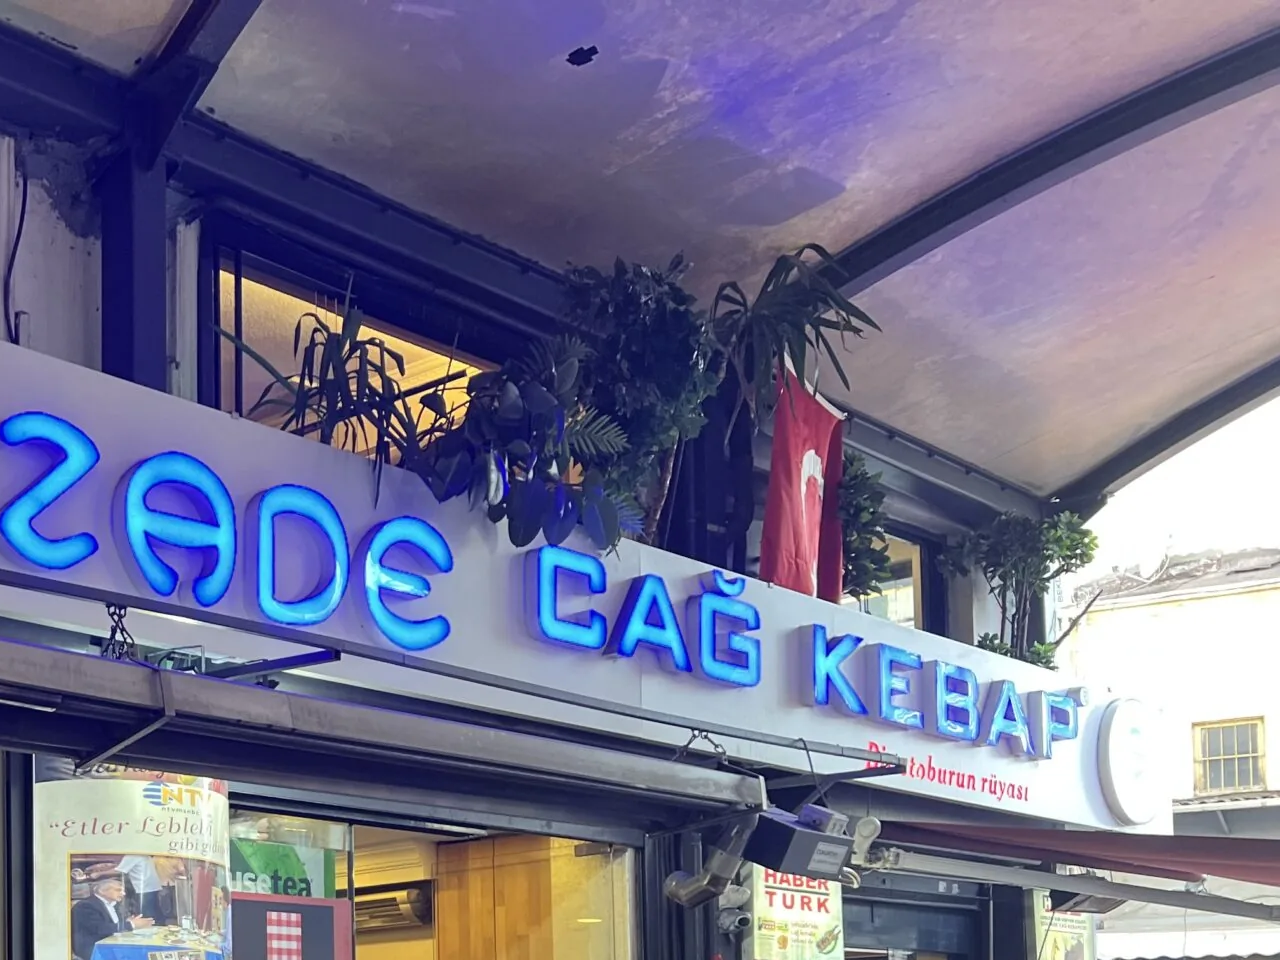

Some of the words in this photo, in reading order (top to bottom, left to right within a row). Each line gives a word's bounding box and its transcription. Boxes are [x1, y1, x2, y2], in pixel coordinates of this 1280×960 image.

[532, 544, 761, 687] CAĞ
[810, 624, 1078, 759] KEBAP
[903, 755, 976, 791] toburun
[981, 774, 1029, 801] rüyası
[765, 890, 831, 914] TURK
